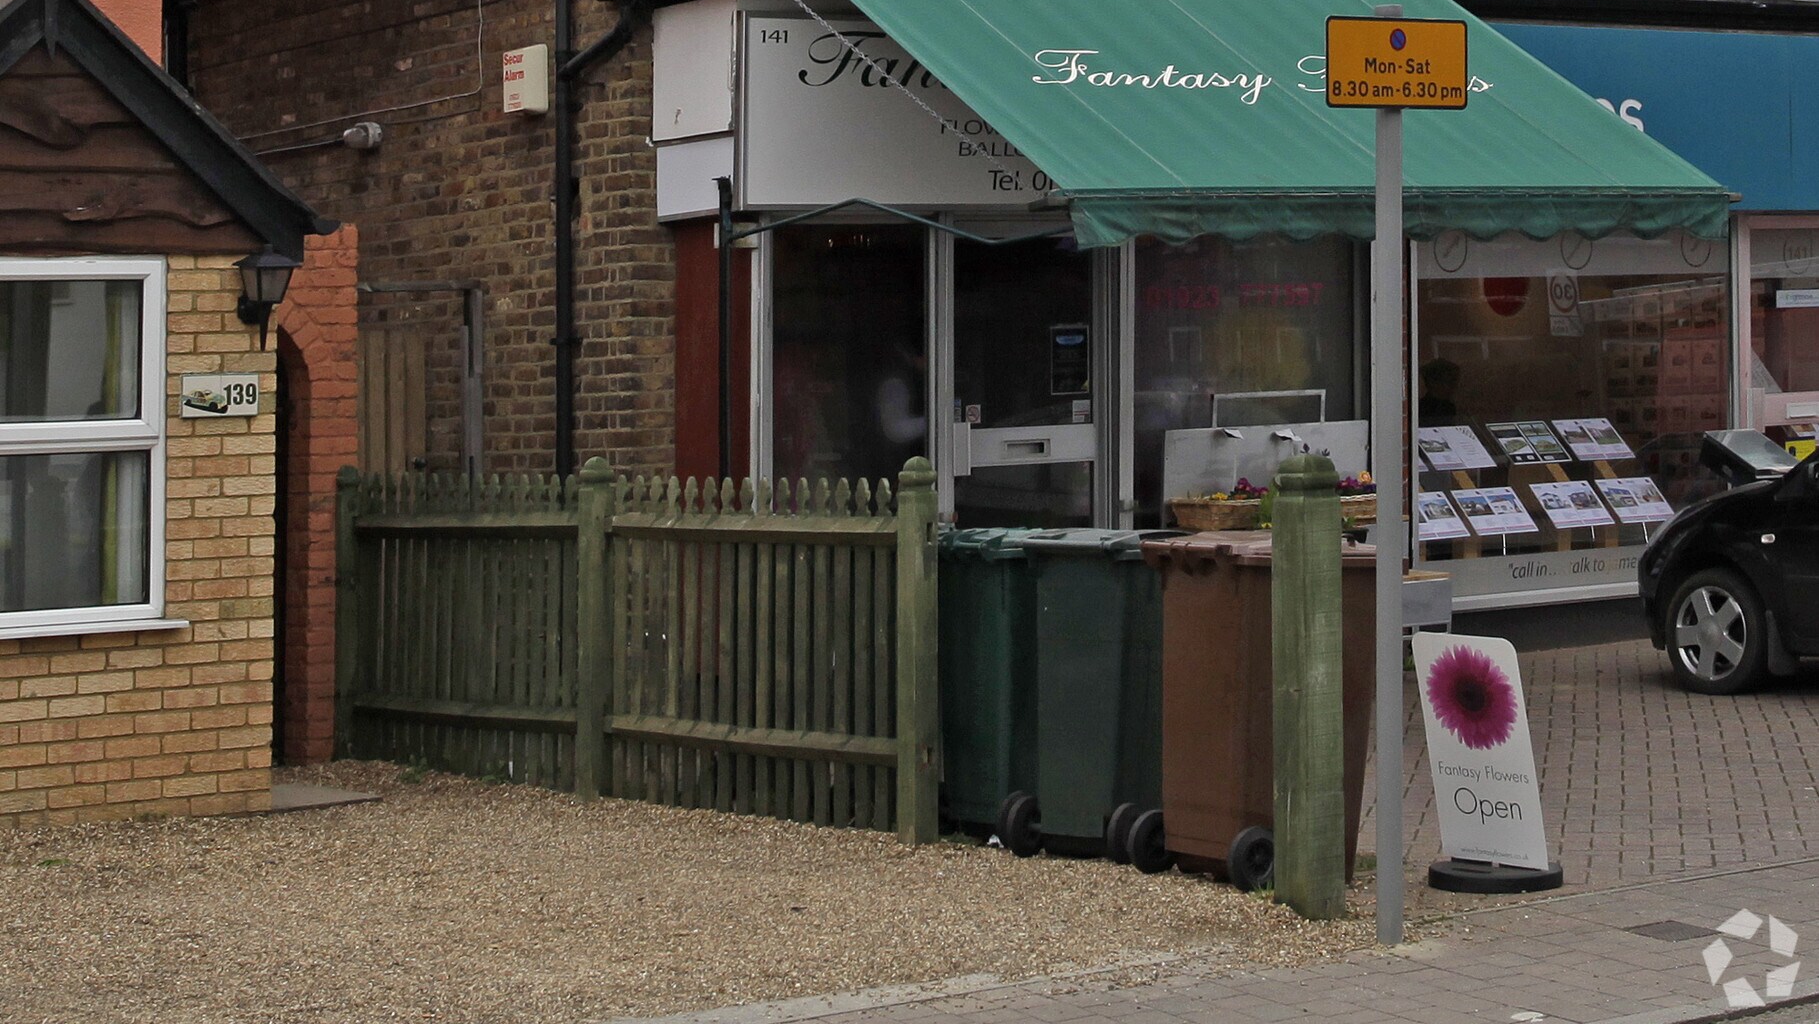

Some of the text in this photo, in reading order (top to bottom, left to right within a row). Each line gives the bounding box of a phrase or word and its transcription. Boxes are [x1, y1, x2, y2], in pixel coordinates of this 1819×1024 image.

[760, 29, 788, 44] 141
[798, 30, 950, 88] Fan
[504, 69, 525, 82] Alarm
[1032, 49, 1272, 105] Fantasy
[1332, 80, 1369, 97] 8.30
[1441, 86, 1463, 101] pm
[988, 170, 1022, 191] Tel.
[223, 383, 257, 406] 139
[1567, 556, 1590, 574] alk
[1594, 558, 1606, 572] to
[1438, 760, 1530, 784] Fantasy Flowers
[1454, 787, 1523, 825] Open
